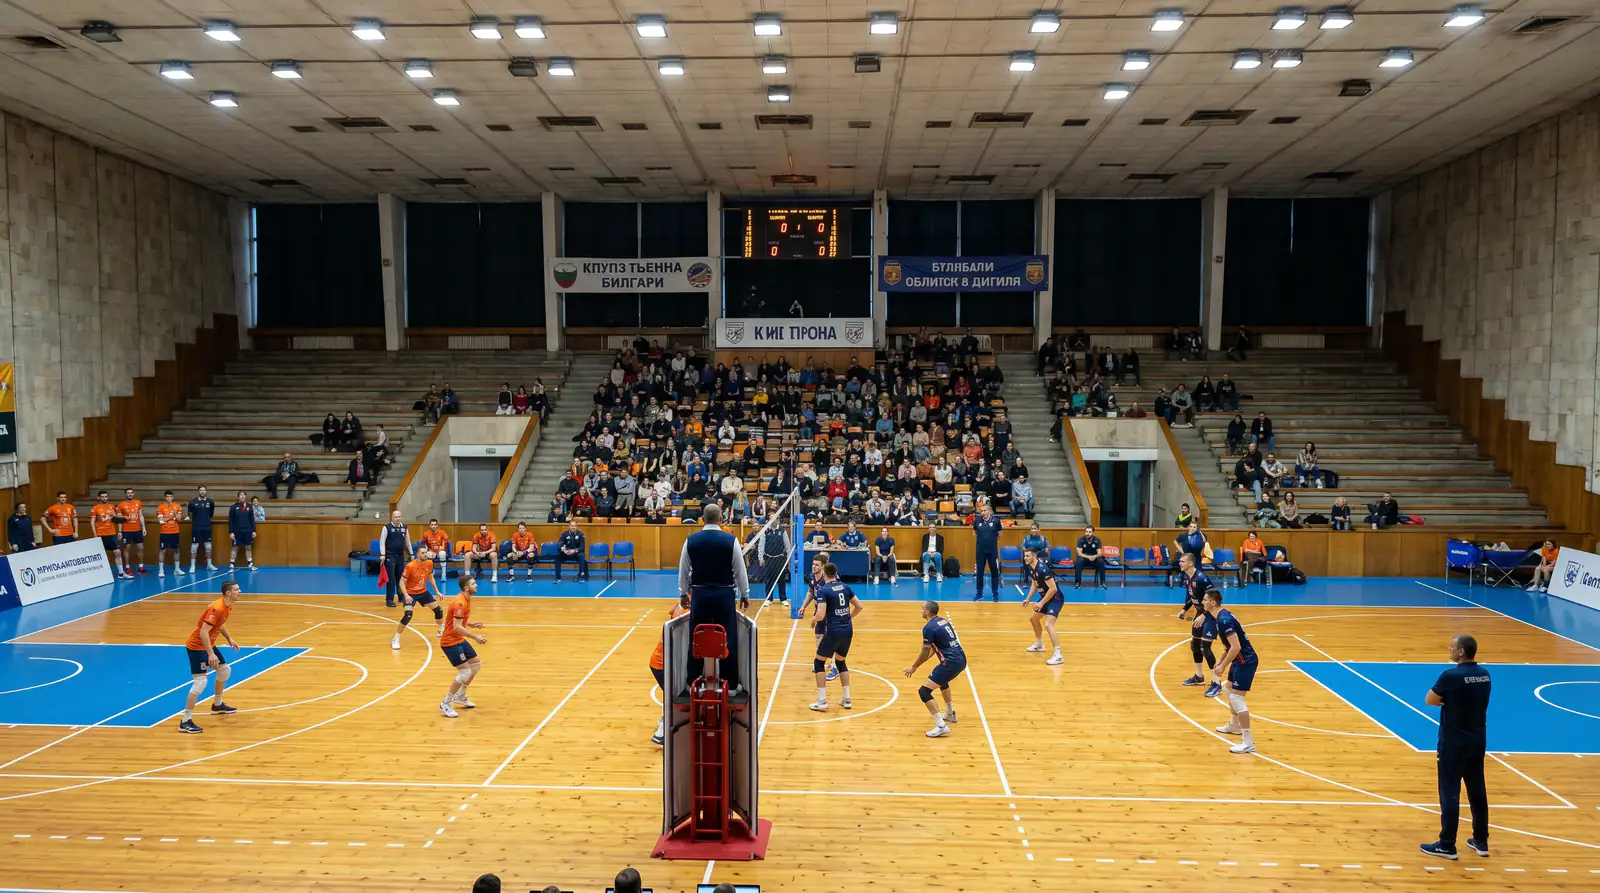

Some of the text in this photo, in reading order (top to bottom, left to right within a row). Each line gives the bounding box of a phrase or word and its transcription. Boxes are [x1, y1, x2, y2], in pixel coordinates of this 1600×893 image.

[781, 222, 787, 232] 0
[817, 222, 825, 232] 0
[771, 246, 826, 256] 0 0
[602, 277, 664, 288] БИЛГАРИ
[838, 592, 846, 606] 8
